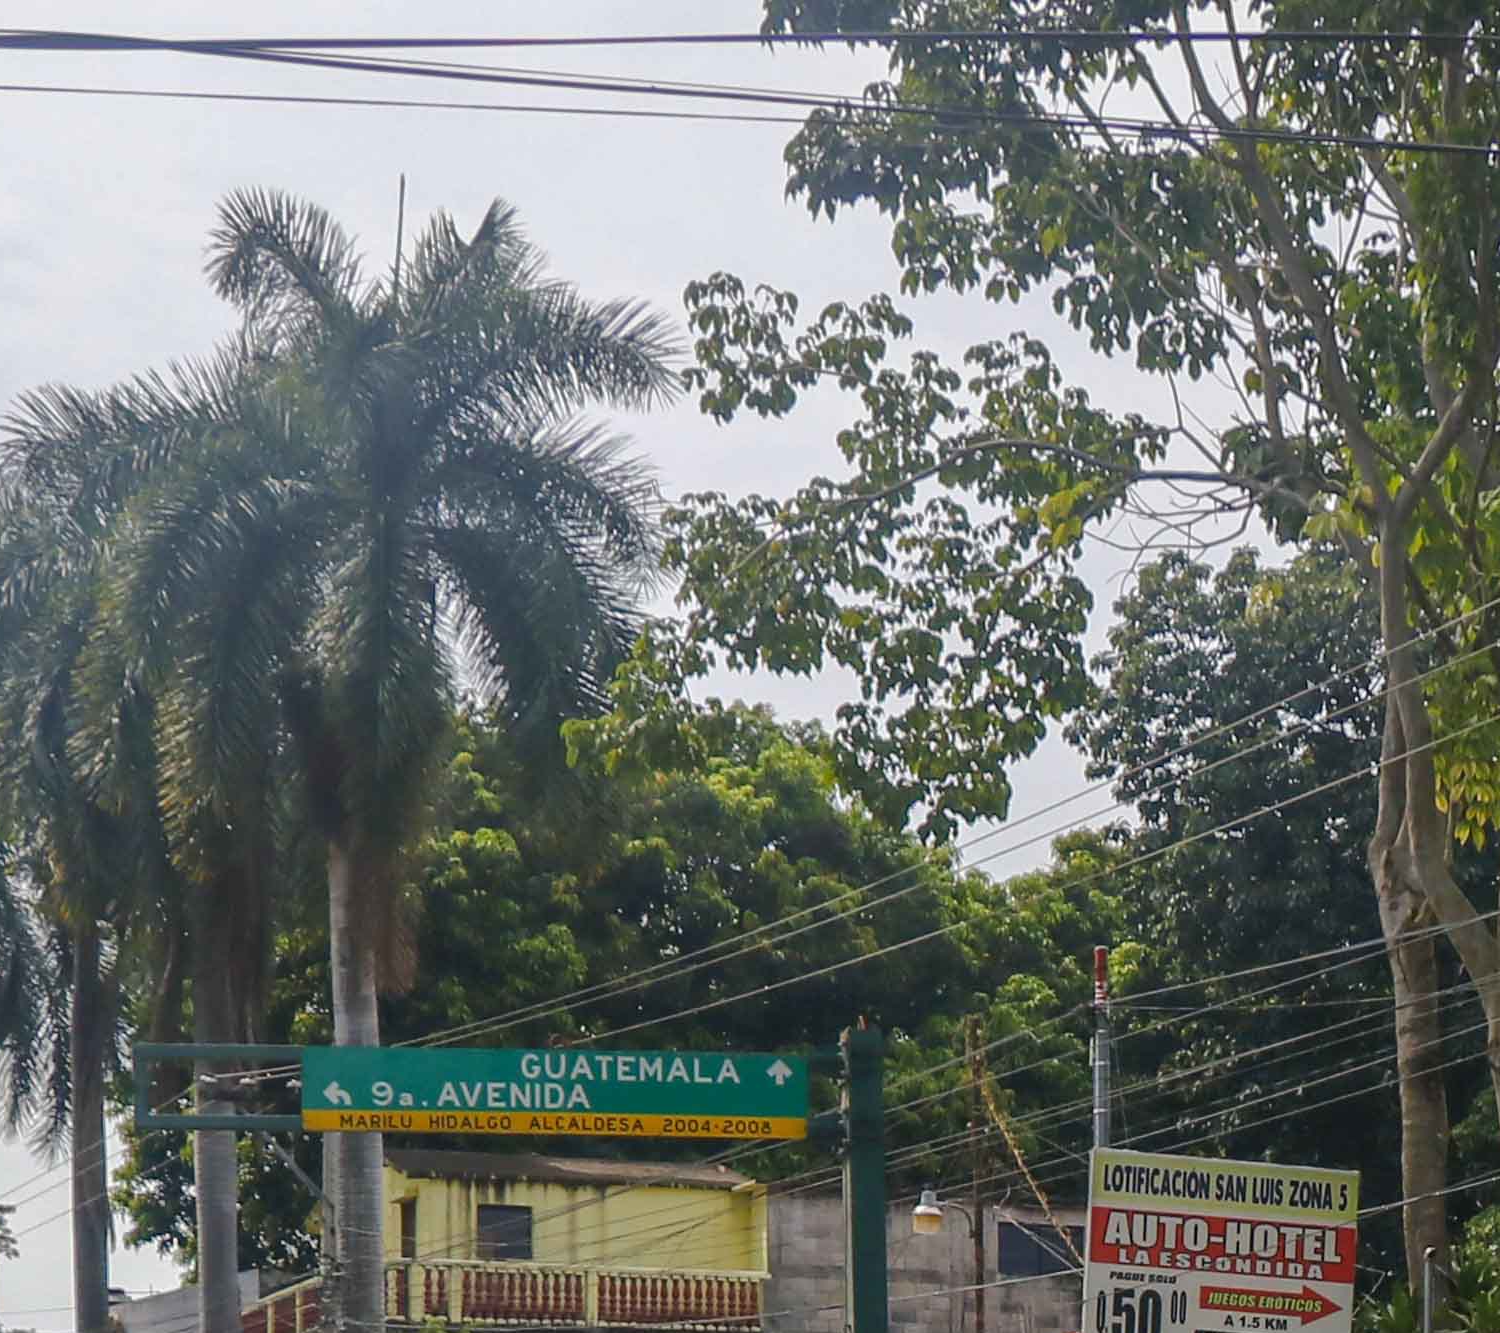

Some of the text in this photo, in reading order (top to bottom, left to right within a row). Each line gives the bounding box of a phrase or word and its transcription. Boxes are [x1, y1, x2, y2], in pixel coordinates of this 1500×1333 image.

[520, 1053, 741, 1085] GUATEMALA
[437, 1082, 591, 1110] AVENIDA
[339, 1114, 413, 1129] MARILU
[428, 1116, 512, 1130] HIDALGO
[529, 1117, 644, 1132] ALCALDESA
[1216, 1174, 1247, 1203] SAN
[1253, 1177, 1284, 1206] LUIS
[1289, 1180, 1333, 1210] ZONA
[1339, 1183, 1348, 1211] 5
[1104, 1211, 1341, 1263] AUTO-HOTEL
[1109, 1271, 1145, 1282] PAGUE
[1119, 1249, 1323, 1280] LA ESCONDIDA
[1208, 1292, 1255, 1308] JUEGOS
[1224, 1314, 1287, 1331] A 1.5 KM
